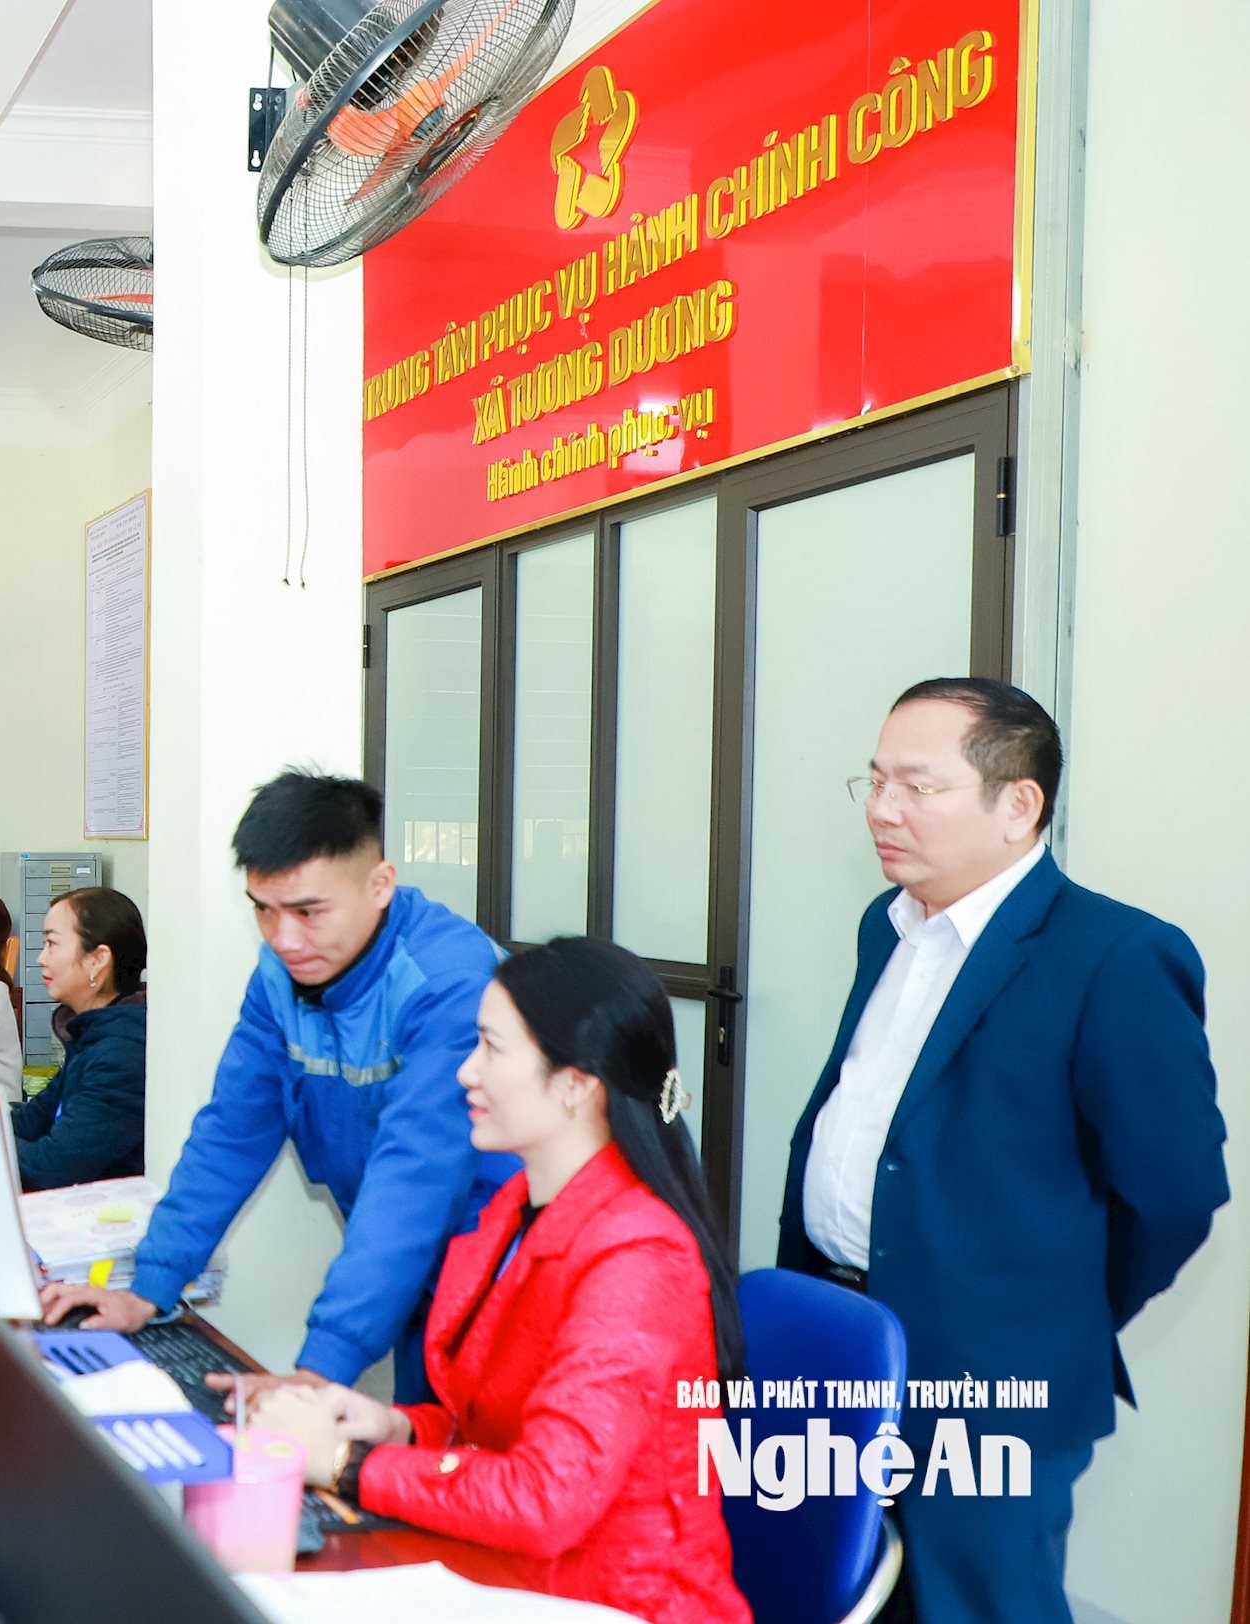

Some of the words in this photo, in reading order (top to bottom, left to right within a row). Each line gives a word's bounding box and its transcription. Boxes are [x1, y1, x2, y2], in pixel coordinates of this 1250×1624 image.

[364, 350, 432, 421] TRUNG
[431, 321, 478, 385] TÂM
[479, 279, 553, 355] PHỤC
[554, 251, 598, 324] VỤ
[602, 193, 699, 296] HÀNH
[705, 113, 838, 239] CHÍNH
[847, 30, 993, 164] CÔNG
[472, 375, 507, 445] XÃ
[507, 341, 603, 427] TƯƠNG
[608, 280, 734, 387] DƯƠNG
[487, 449, 539, 502] Hành
[540, 422, 606, 481] chính
[608, 405, 679, 468] phục
[678, 388, 715, 439] vụ
